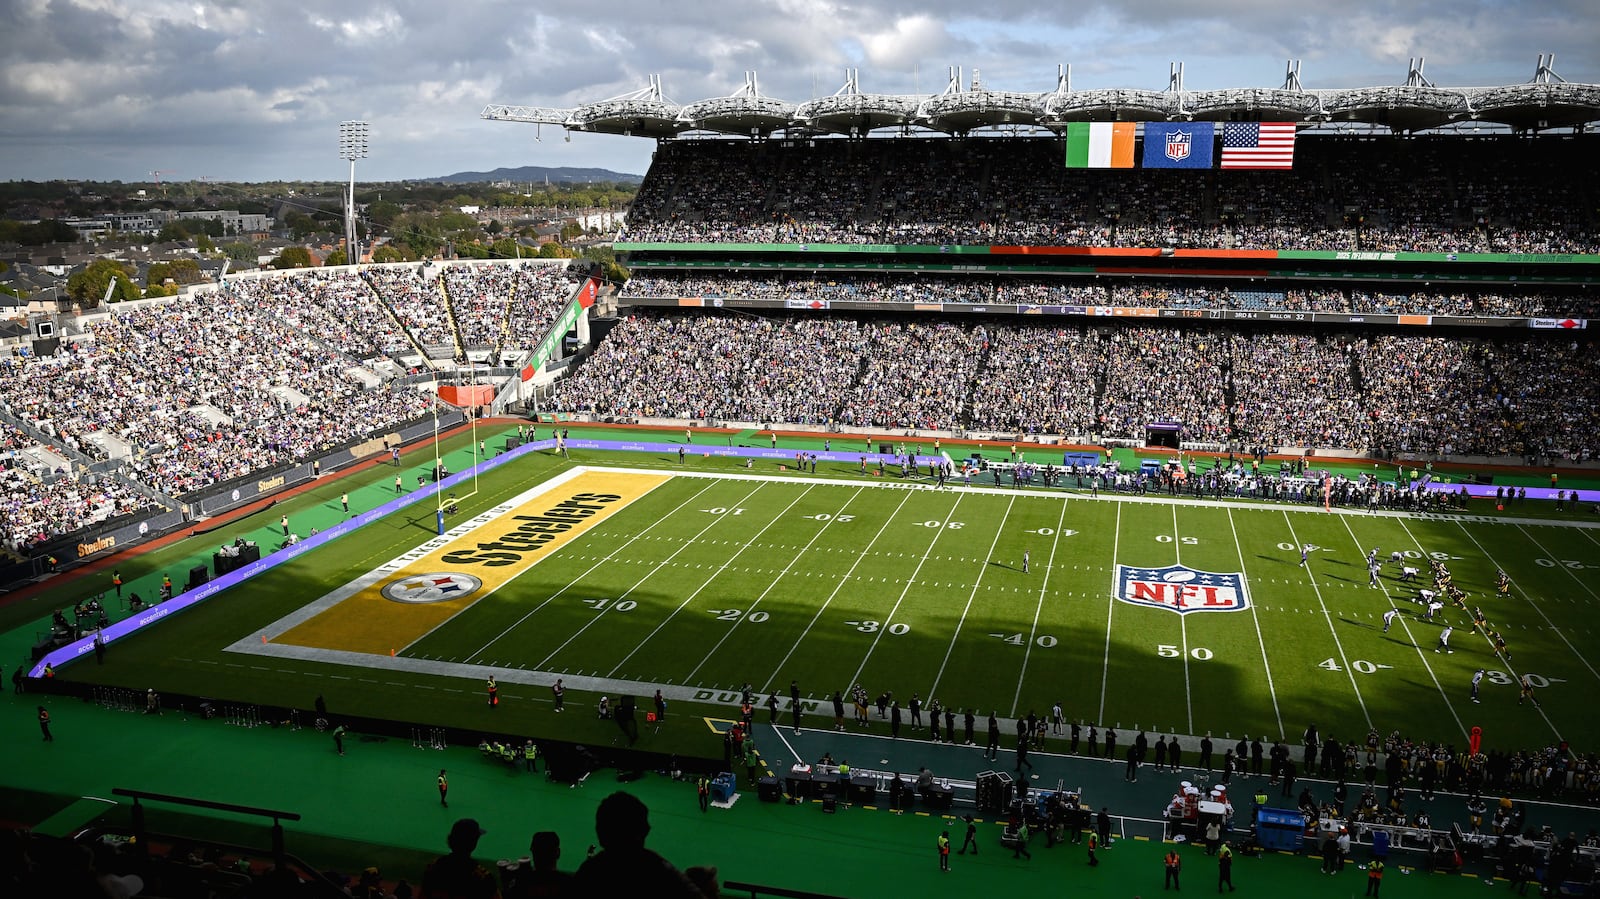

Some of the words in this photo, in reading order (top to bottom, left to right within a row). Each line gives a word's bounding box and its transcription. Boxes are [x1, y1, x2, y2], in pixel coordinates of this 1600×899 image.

[1169, 144, 1188, 156] NFL
[1182, 310, 1203, 318] 11:50
[258, 475, 285, 493] Steelers
[441, 493, 622, 567] Steelers
[378, 564, 399, 573] IT
[398, 539, 450, 561] TAKES
[447, 524, 477, 537] ALL
[476, 513, 493, 523] OF
[497, 504, 513, 514] US
[77, 536, 115, 557] Steelers
[243, 563, 267, 578] accenture
[194, 584, 220, 600] accenture
[1131, 581, 1233, 607] NFL
[589, 598, 637, 612] 10
[139, 608, 168, 625] accenture
[716, 609, 770, 623] 20
[857, 620, 911, 635] 30
[1003, 633, 1058, 648] 40
[1158, 645, 1214, 660] 50
[1318, 657, 1377, 674] 40
[1486, 670, 1550, 688] 30
[1419, 816, 1428, 826] 94
